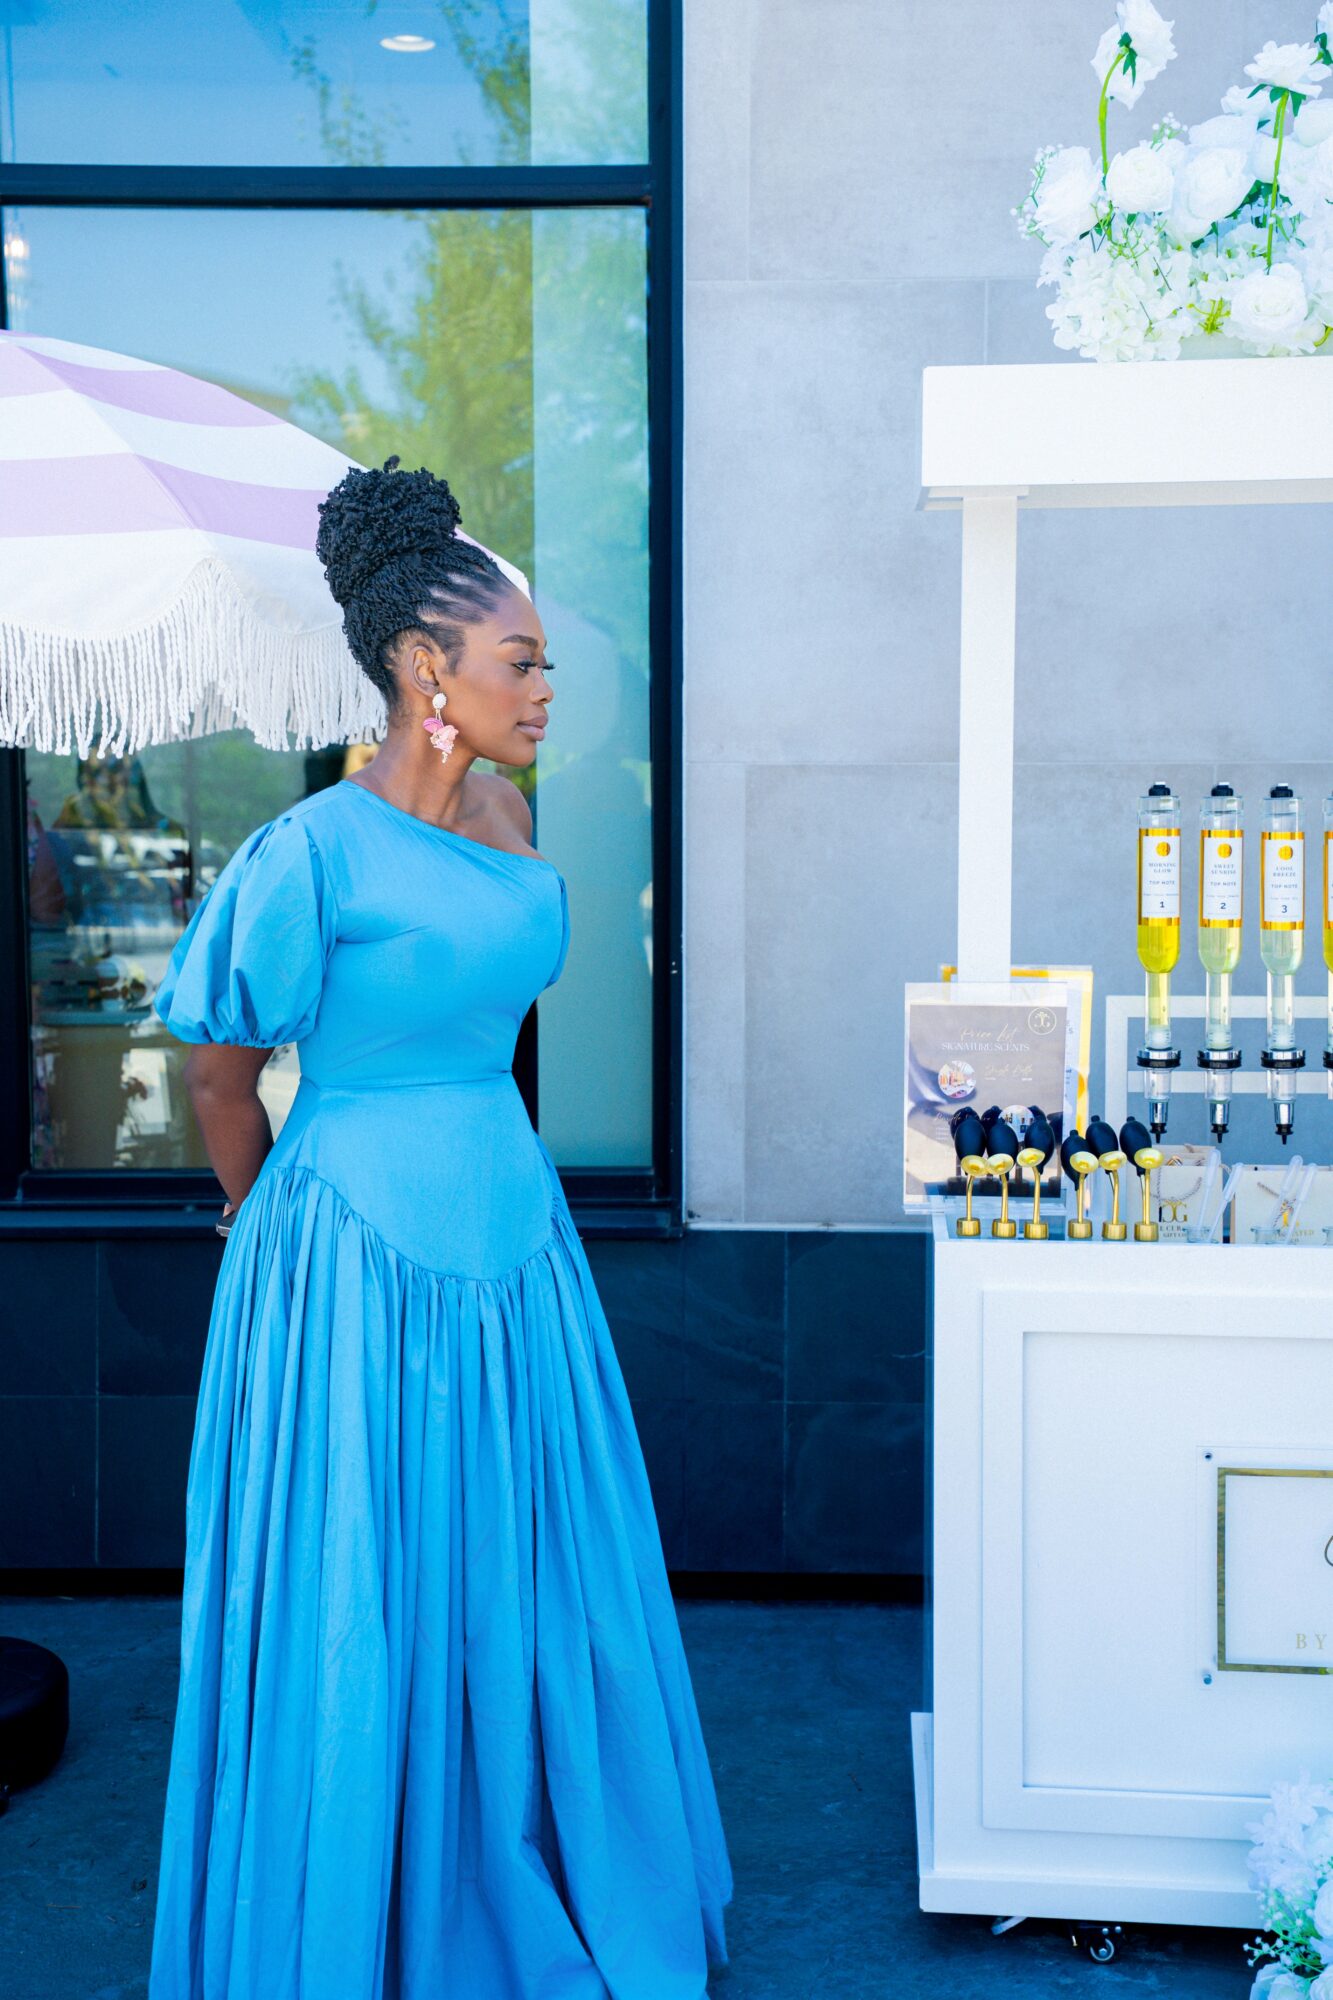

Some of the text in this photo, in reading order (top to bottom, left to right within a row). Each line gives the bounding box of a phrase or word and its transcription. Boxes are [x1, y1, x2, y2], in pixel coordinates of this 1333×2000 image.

[1281, 904, 1288, 913] 3
[941, 1042, 1030, 1051] SIGNATURE SCENTS
[1296, 1632, 1327, 1649] BY
